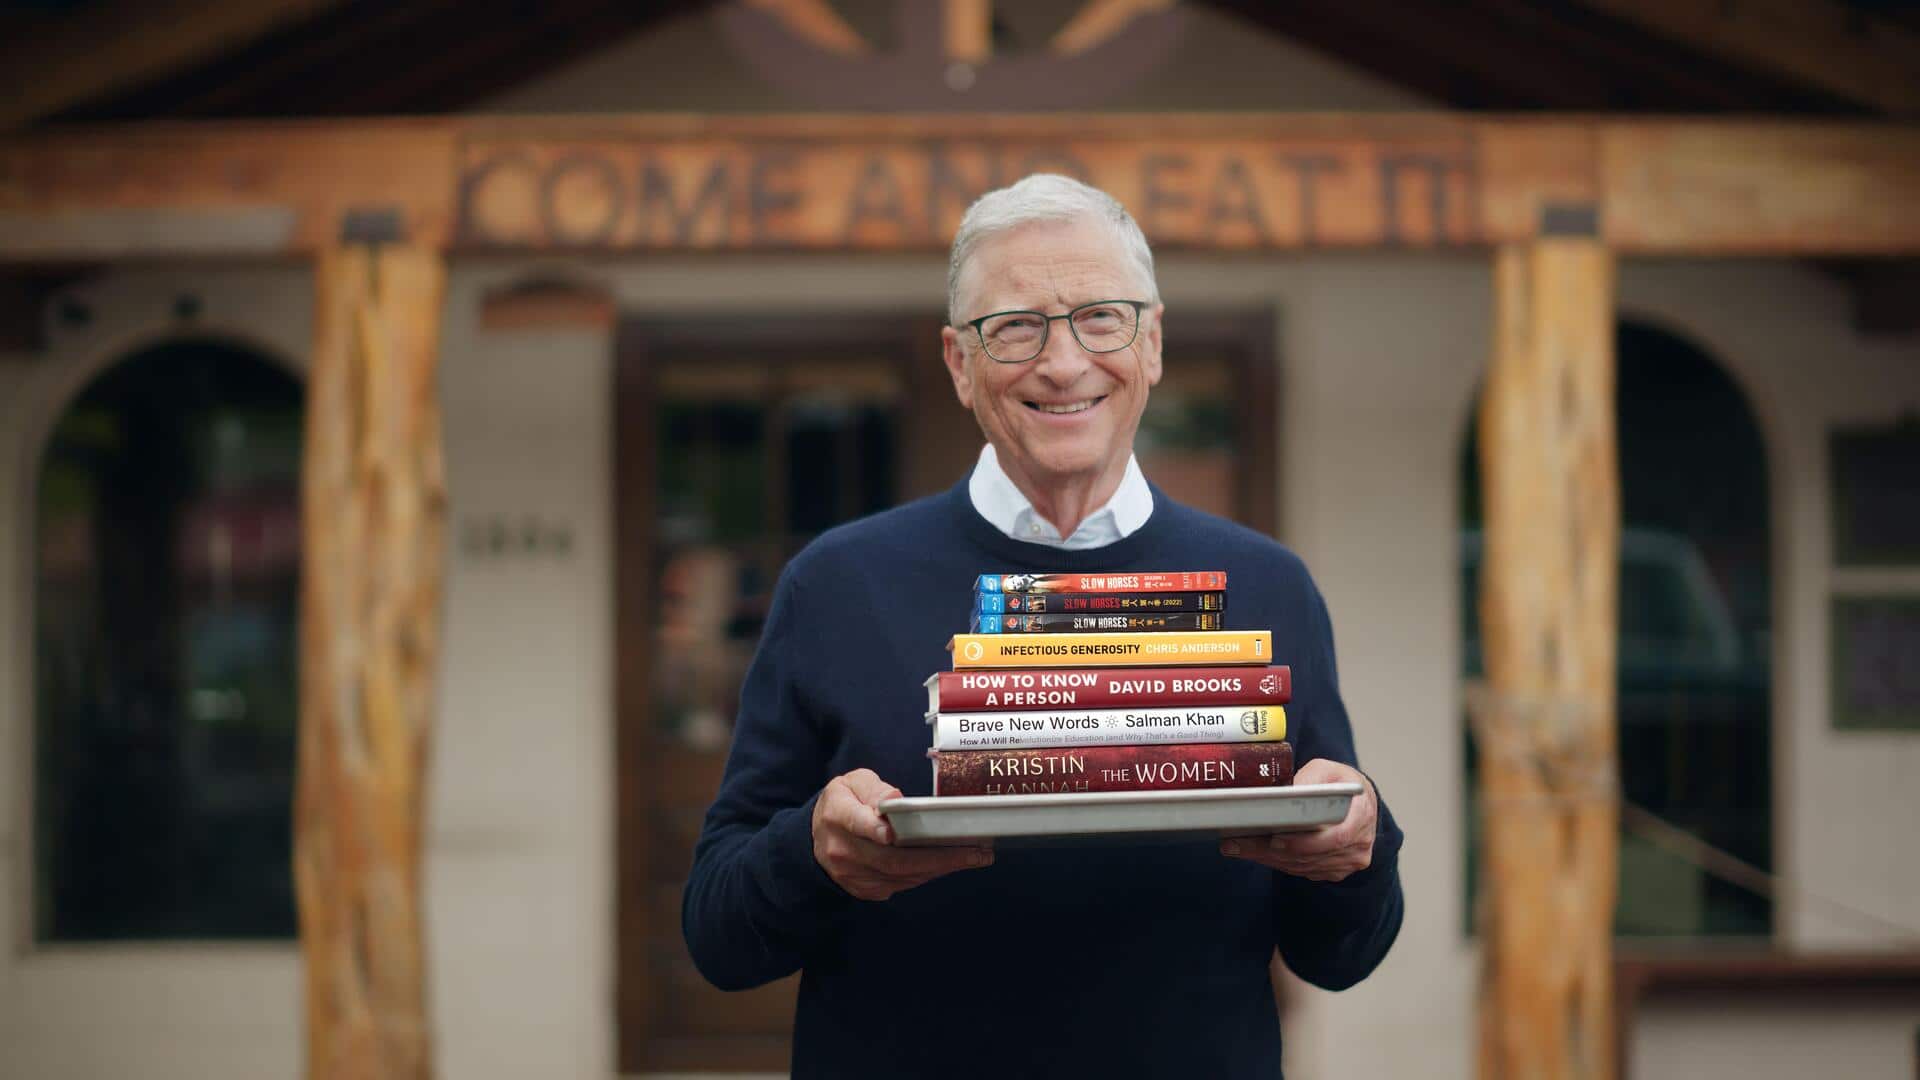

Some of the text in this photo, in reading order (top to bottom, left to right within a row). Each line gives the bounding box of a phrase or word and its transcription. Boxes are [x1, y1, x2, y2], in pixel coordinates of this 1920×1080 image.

[463, 143, 808, 247] COME
[1140, 146, 1344, 247] EAT
[1081, 577, 1106, 589] SLOW
[1107, 576, 1139, 589] HORSES
[1064, 598, 1121, 609] SLOW HORSES
[1074, 617, 1097, 629] SLOW
[1098, 617, 1128, 628] HORSES
[1000, 642, 1240, 656] INFECTIOUS GENEROSITY CHRIS ANDERSON
[962, 673, 1098, 689] HOW TO KNOW
[1109, 678, 1242, 694] DAVID BROOKS
[985, 691, 1076, 705] A PERSON
[959, 715, 1100, 733] Brave New Words
[1125, 712, 1225, 728] Salman Khan
[1260, 710, 1269, 734] Viking
[960, 738, 978, 746] How
[992, 737, 1007, 745] Will
[1064, 734, 1104, 743] Education
[1125, 732, 1142, 741] Why
[1145, 732, 1168, 740] That's
[1176, 731, 1198, 739] Good
[1199, 730, 1224, 739] Thing)
[989, 755, 1085, 777] KRISTIN
[1100, 760, 1236, 783] THE WOMEN
[986, 780, 1090, 795] HANNAH
